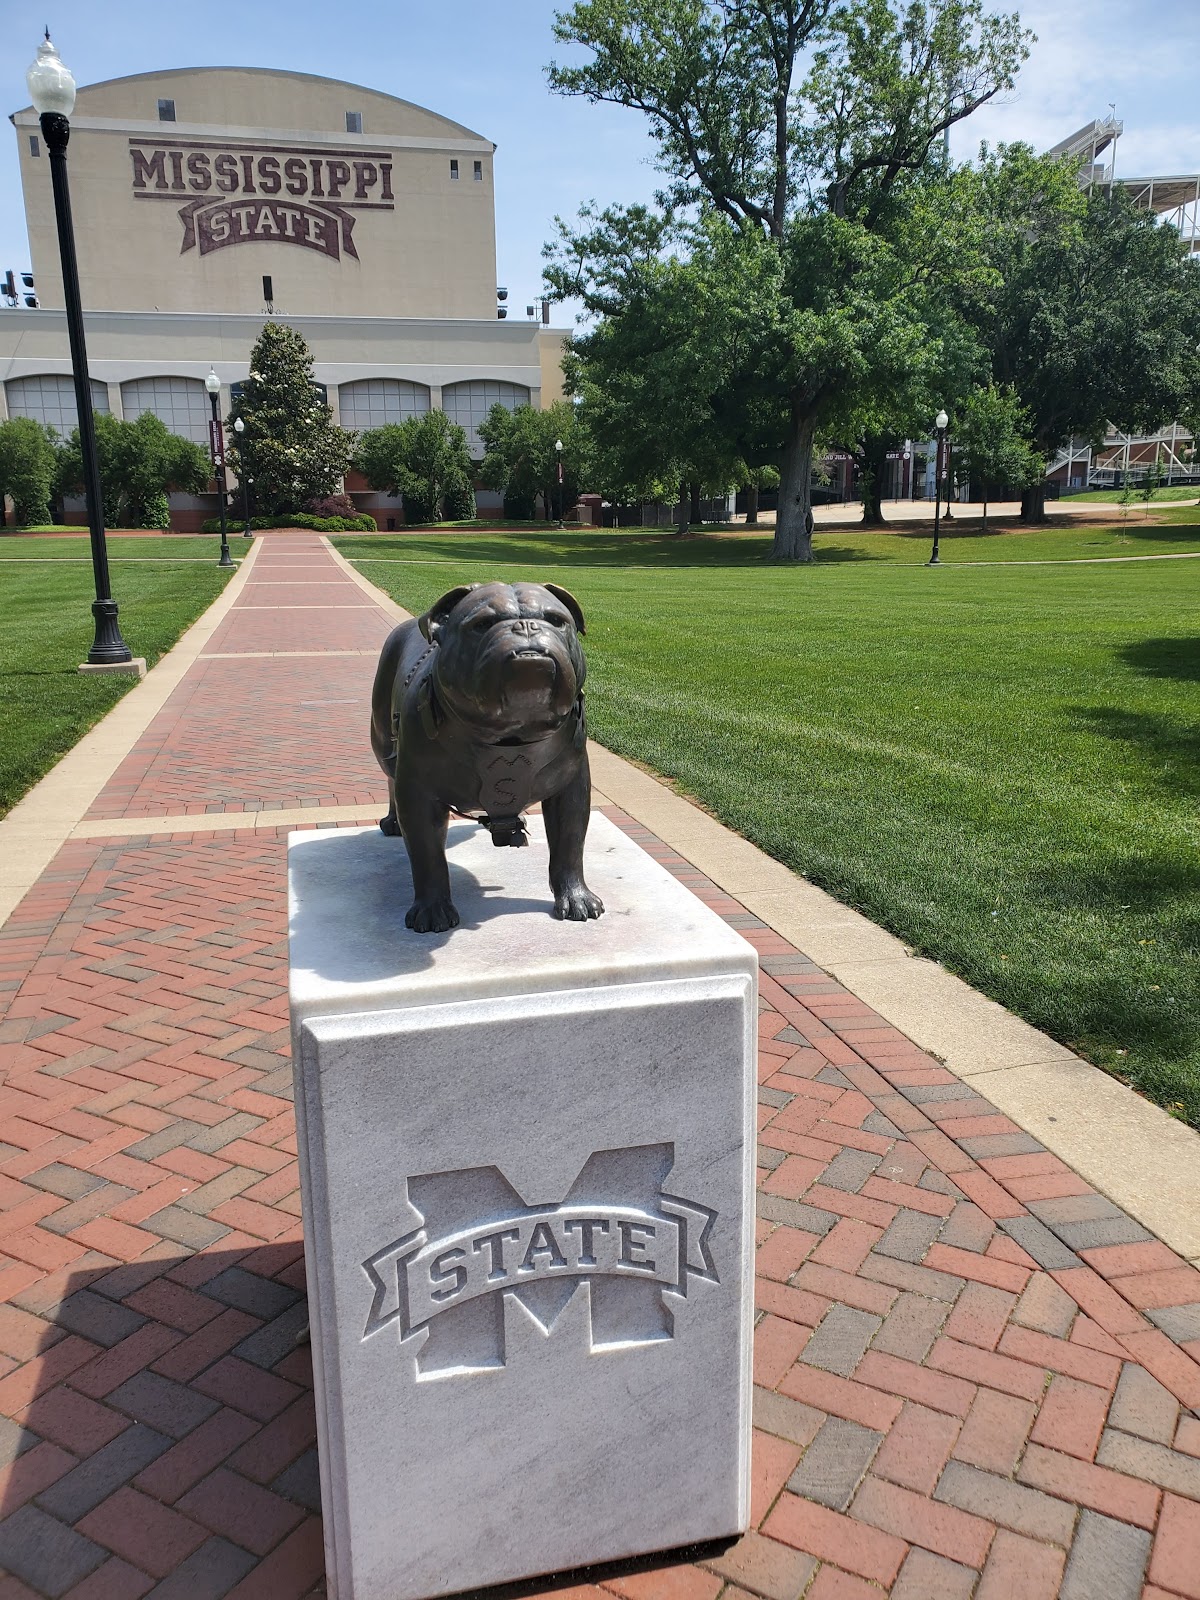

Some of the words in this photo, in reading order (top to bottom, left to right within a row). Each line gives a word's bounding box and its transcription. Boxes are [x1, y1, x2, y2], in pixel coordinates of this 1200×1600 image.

[129, 149, 394, 200] MISSISSIPPI
[210, 205, 327, 247] STATE
[428, 1218, 656, 1303] STATE
